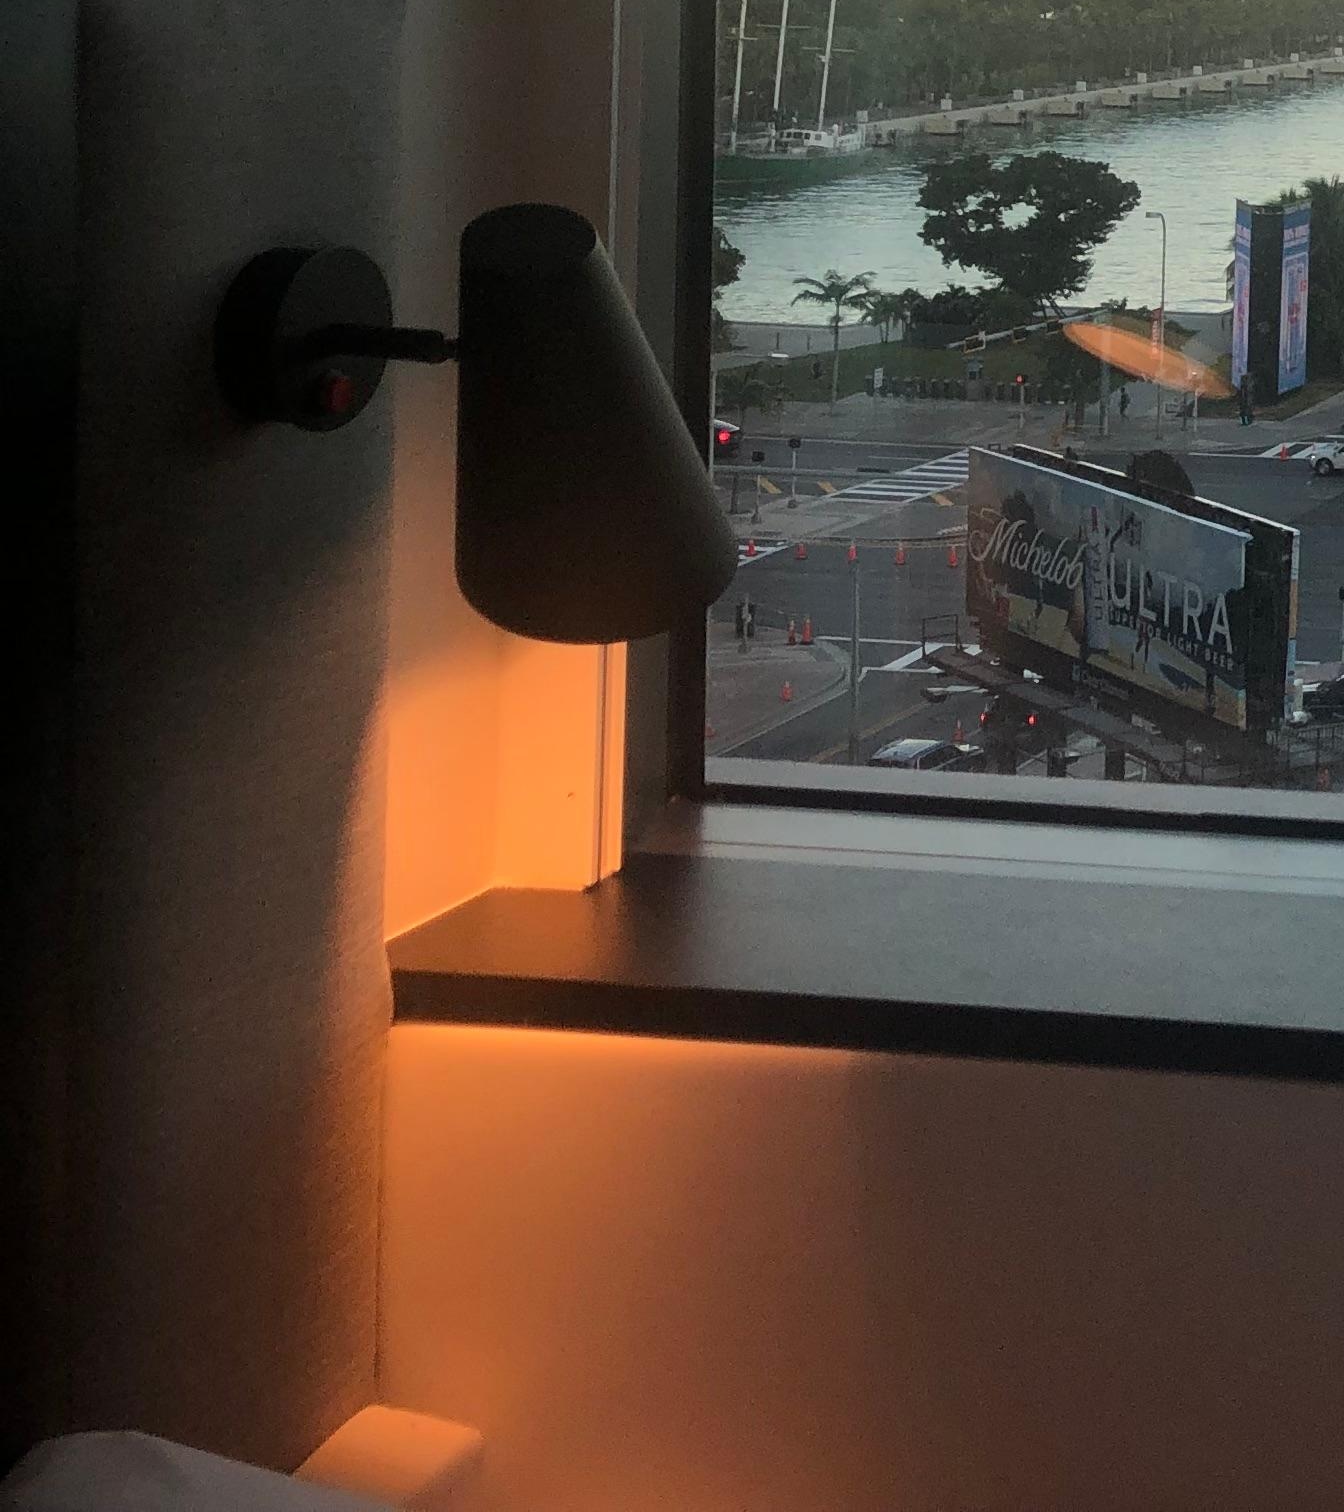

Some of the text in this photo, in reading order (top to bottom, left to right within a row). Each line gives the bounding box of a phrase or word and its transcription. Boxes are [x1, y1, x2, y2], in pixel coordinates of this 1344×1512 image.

[969, 507, 1088, 589] Michelob
[1108, 552, 1234, 655] ULTRA
[1109, 603, 1162, 639] SUPEOR
[1204, 647, 1234, 673] BEER
